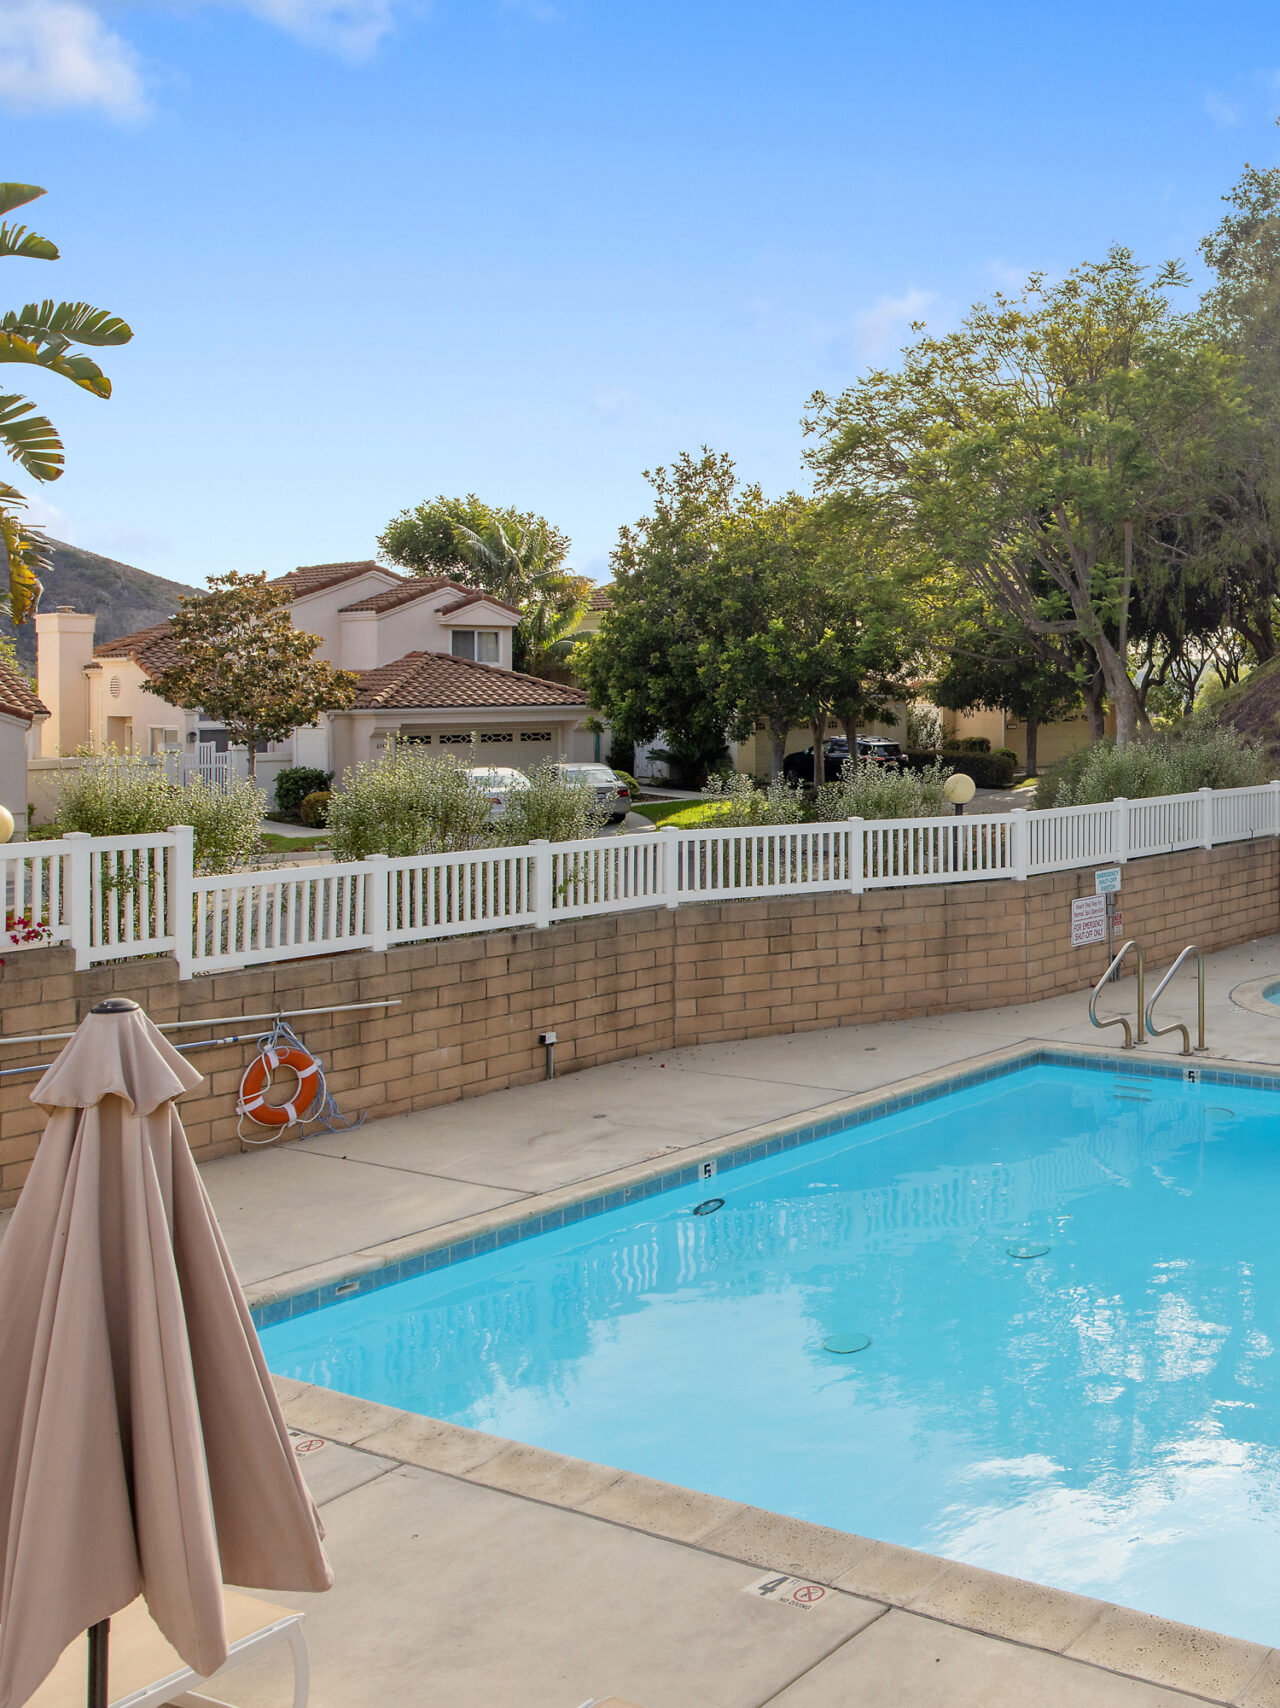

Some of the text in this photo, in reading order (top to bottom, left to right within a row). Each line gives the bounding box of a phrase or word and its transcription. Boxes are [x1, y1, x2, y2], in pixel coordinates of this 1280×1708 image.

[1097, 870, 1118, 879] EMERGENCY
[1099, 876, 1117, 885] SHUT-OFF
[1082, 920, 1103, 930] EMERGENCY
[1074, 928, 1103, 941] SHUT-OFF ONLY
[1188, 1070, 1195, 1083] 5
[704, 1162, 712, 1179] 5
[758, 1575, 790, 1596] 4
[790, 1601, 811, 1610] DIVING
